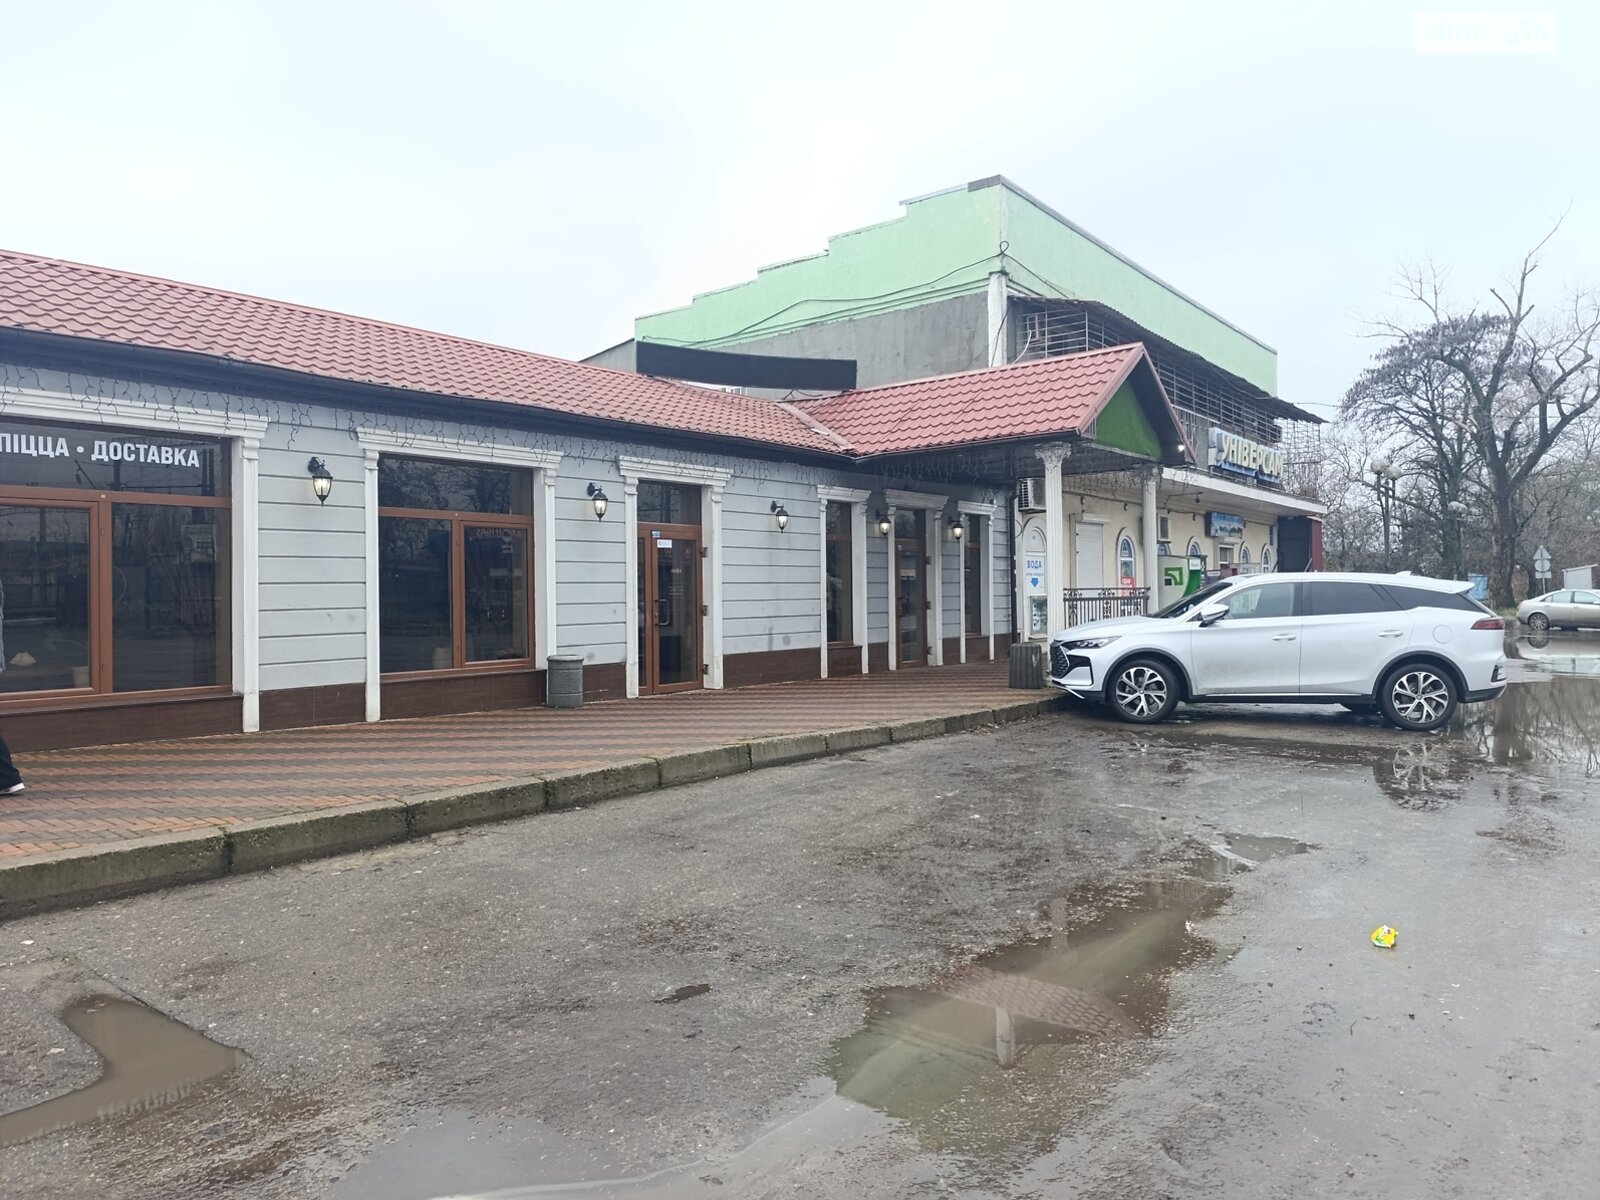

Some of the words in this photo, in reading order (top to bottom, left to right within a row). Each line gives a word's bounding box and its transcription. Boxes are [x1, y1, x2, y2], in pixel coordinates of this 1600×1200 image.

[0, 432, 69, 458] ПІЦЦА
[91, 440, 200, 467] ДОСТАВКА
[1026, 560, 1042, 569] ВОДА
